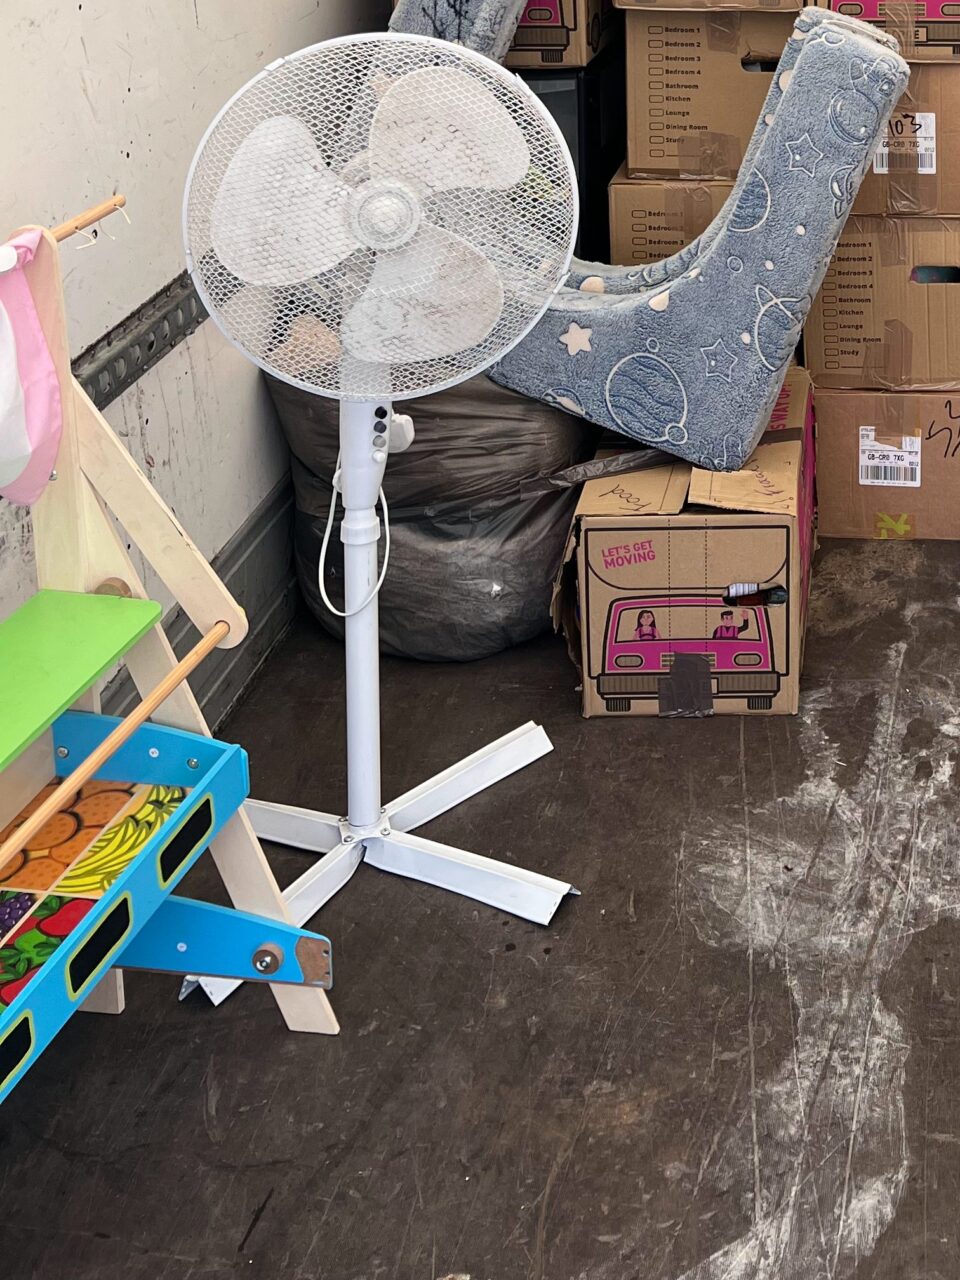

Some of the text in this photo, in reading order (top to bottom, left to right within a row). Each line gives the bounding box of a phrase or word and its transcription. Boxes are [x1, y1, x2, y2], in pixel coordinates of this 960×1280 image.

[839, 323, 863, 331] Lounge
[598, 484, 652, 512] Food
[601, 540, 654, 559] LET'S GET
[604, 550, 656, 569] MOVING
